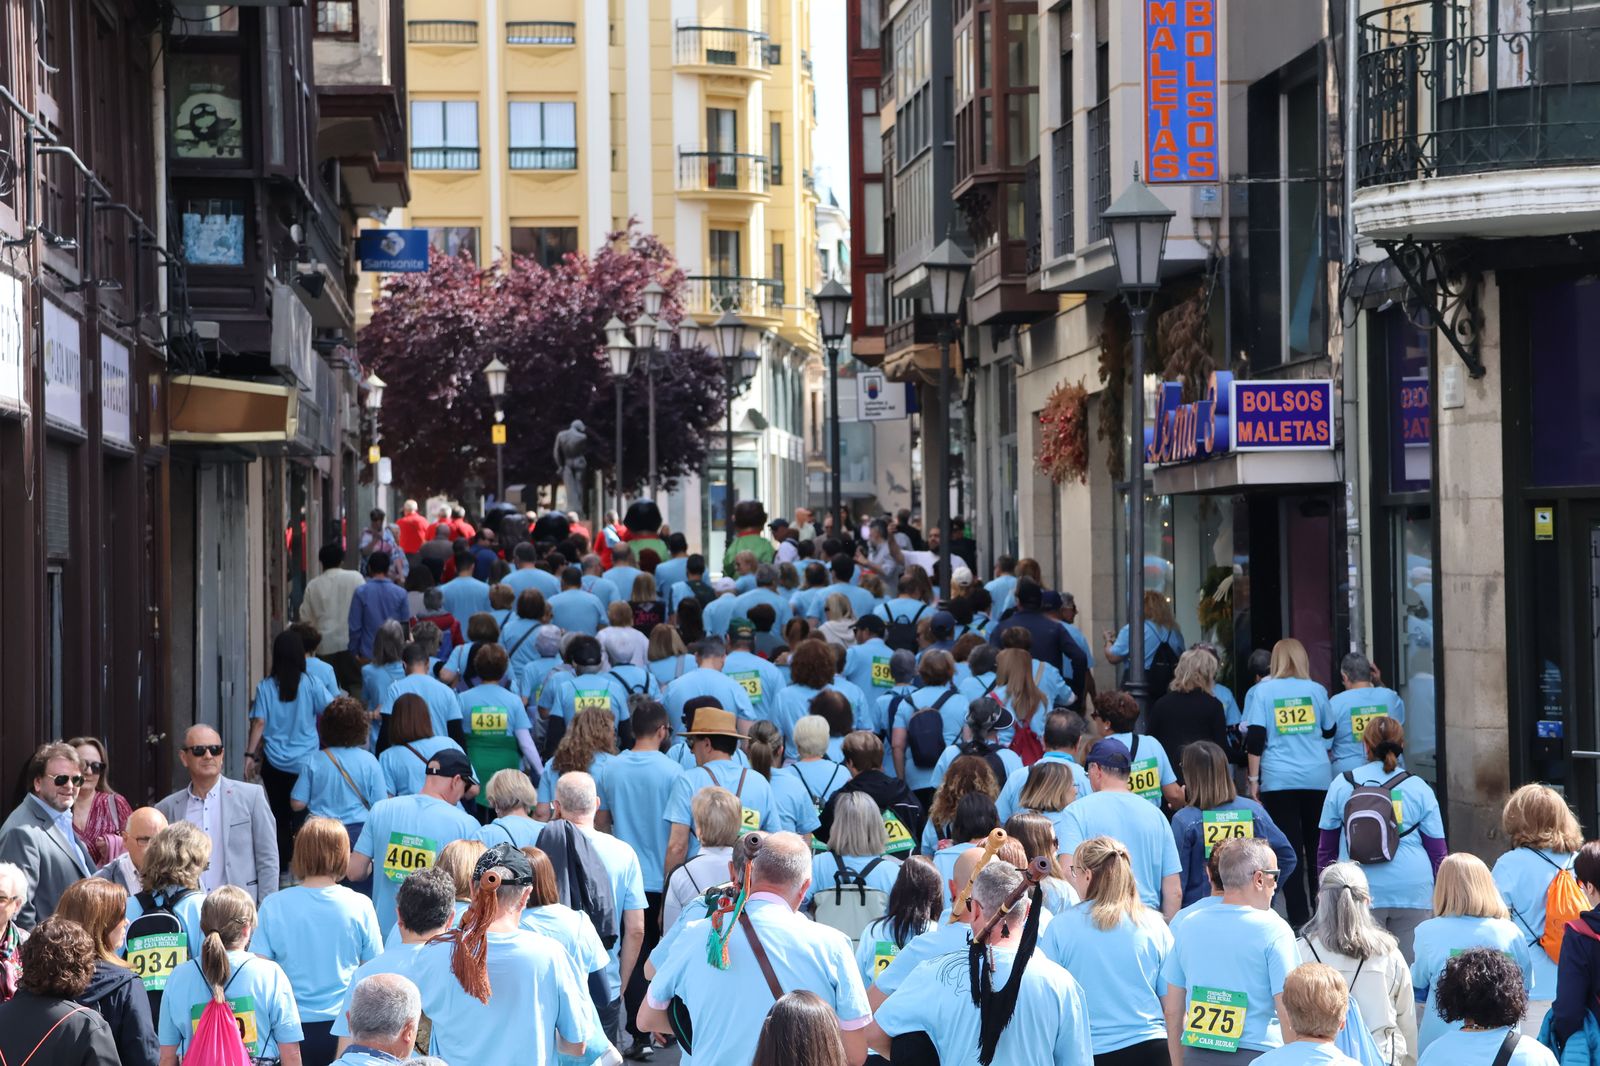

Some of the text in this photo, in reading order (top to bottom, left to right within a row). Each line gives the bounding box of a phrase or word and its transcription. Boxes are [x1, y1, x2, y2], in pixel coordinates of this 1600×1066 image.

[1150, 1, 1180, 178] MALETAS
[1185, 1, 1215, 178] BOLSOS
[364, 258, 424, 270] Samsonite
[1242, 391, 1323, 412] BOLSOS
[1237, 420, 1329, 442] MALETAS
[475, 714, 502, 728] 431
[1279, 708, 1308, 725] 312
[1207, 824, 1245, 844] 276
[387, 847, 426, 868] 406
[133, 951, 178, 975] 934
[1190, 1005, 1236, 1034] 275
